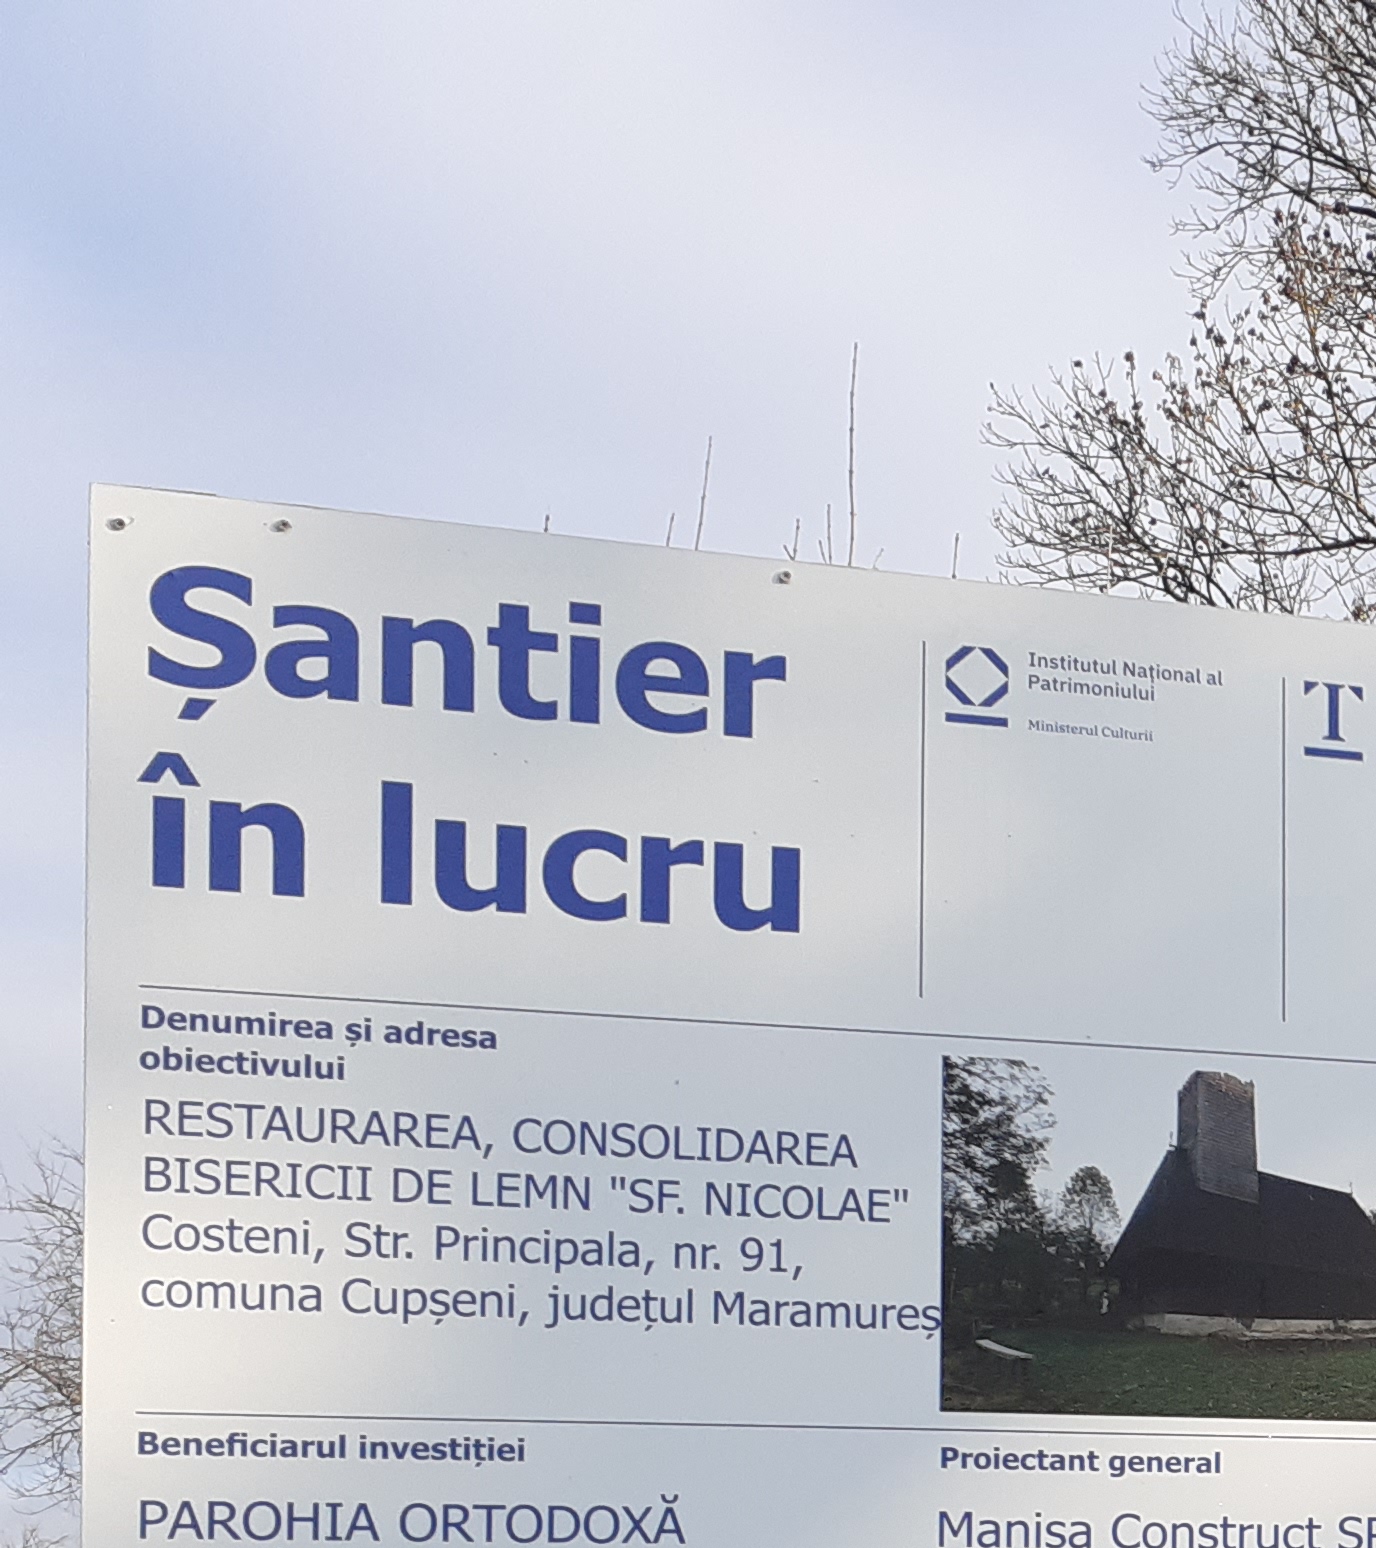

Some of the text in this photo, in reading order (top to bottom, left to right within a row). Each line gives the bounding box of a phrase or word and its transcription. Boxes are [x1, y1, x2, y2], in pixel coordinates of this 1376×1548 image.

[147, 565, 788, 739] Șantier
[1028, 651, 1223, 687] Institutul Național al
[1027, 673, 1156, 702] Patrimoniului
[1028, 719, 1154, 742] Ministerul Culturii
[136, 750, 801, 934] în lucru
[141, 1004, 498, 1050] Denumirea și adresa
[139, 1045, 345, 1081] obiectivului
[144, 1098, 859, 1169] RESTAURAREA, CONSOLIDAREA
[144, 1156, 909, 1224] BISERICII DE LEMN "SF. NICOLAE"
[142, 1213, 803, 1281] Costeni, Str. Principala, nr. 91,
[141, 1277, 942, 1341] comuna Cupșeni, județul Maramureș
[137, 1431, 526, 1468] Beneficiarul investiției
[940, 1446, 1221, 1478] Proiectant general
[139, 1493, 686, 1545] PAROHIA ORTODOXĂ
